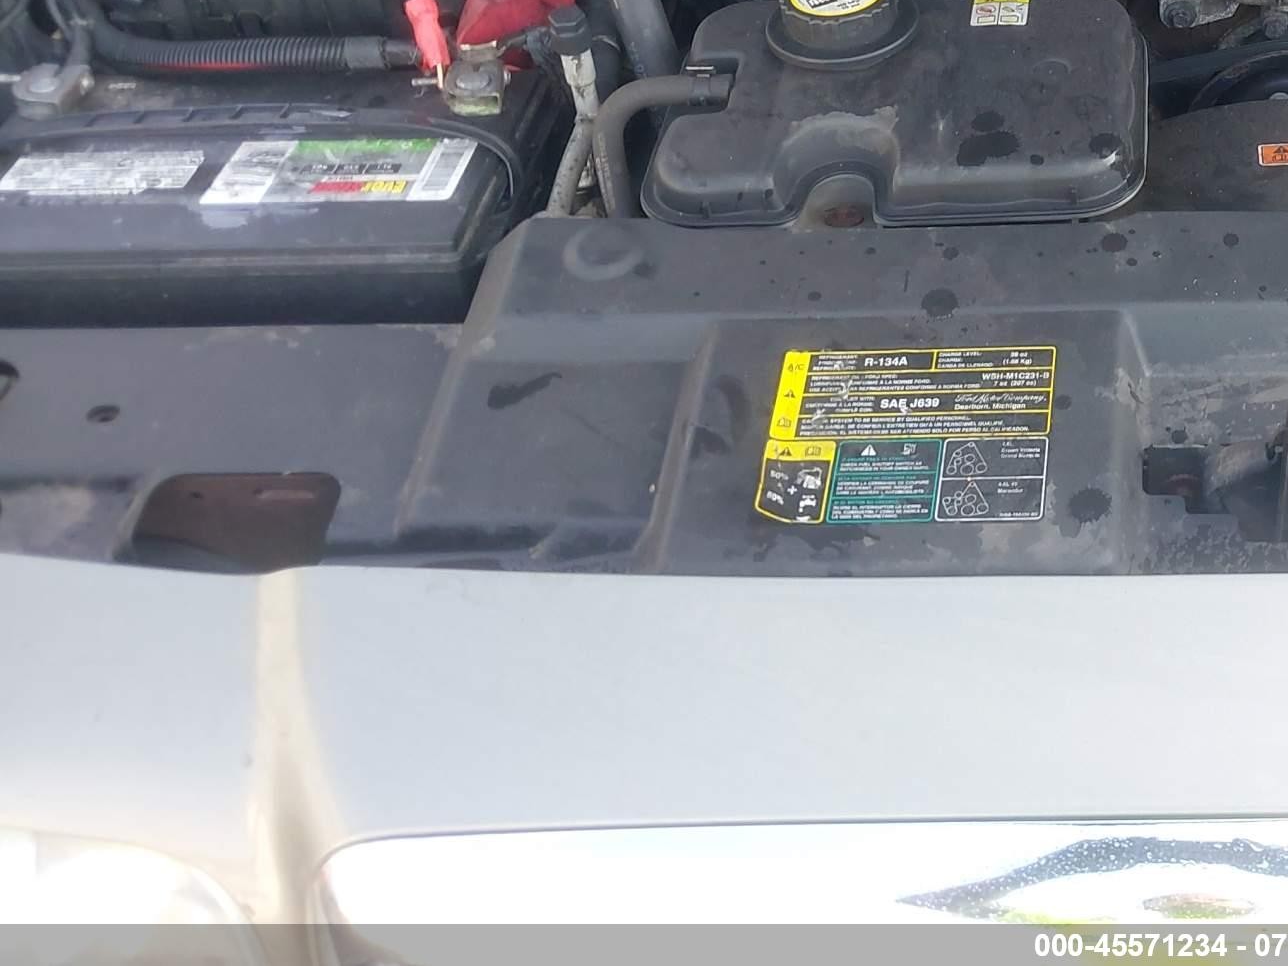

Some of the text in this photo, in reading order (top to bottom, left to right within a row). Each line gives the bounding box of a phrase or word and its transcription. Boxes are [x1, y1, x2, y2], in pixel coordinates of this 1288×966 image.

[864, 356, 908, 366] R-134A
[880, 397, 940, 408] SAE J639
